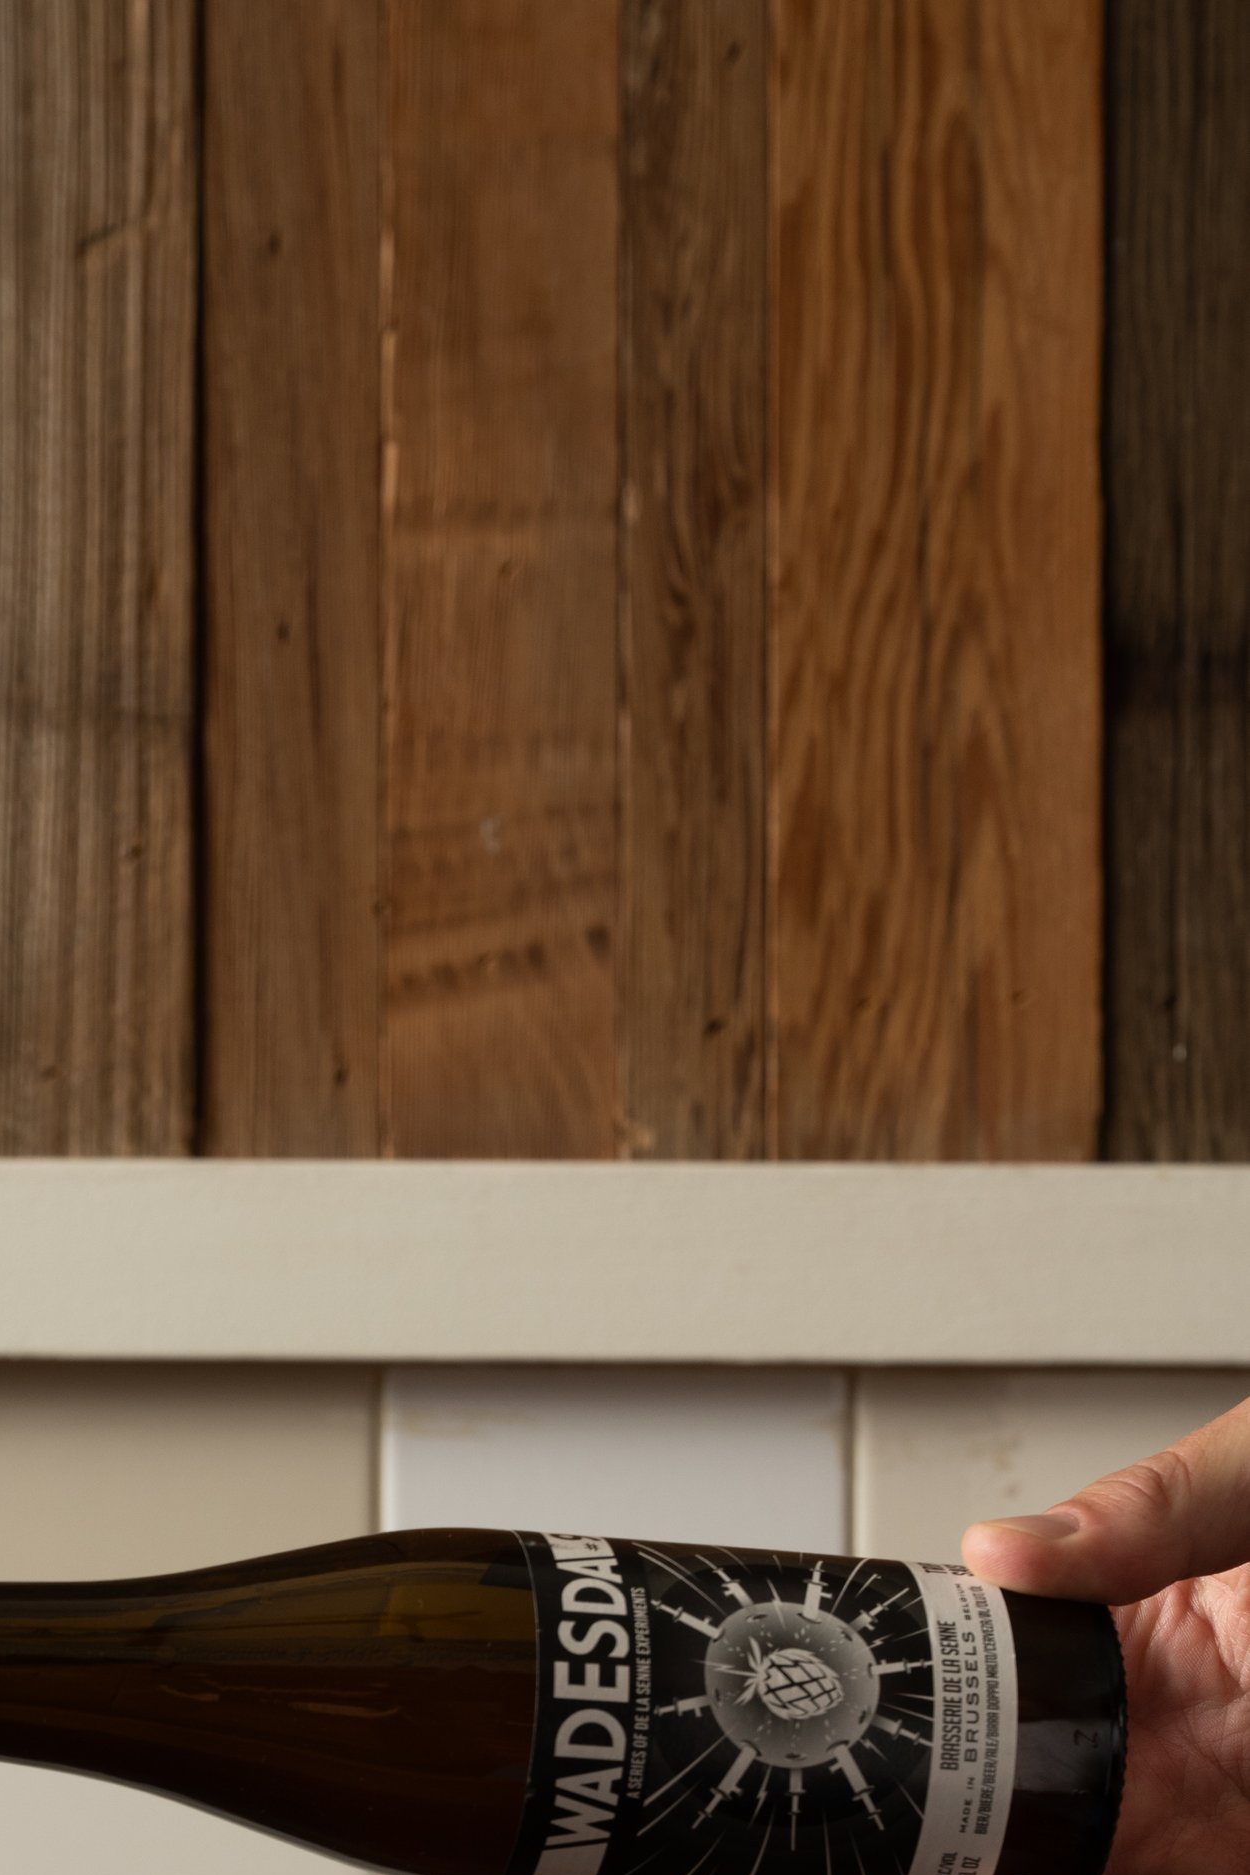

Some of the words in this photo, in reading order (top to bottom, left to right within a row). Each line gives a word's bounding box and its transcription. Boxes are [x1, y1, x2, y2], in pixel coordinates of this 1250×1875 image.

[955, 1583, 971, 1620] BELGIUM
[631, 1587, 651, 1656] EXPERIMENTS
[938, 1620, 960, 1656] SENNE
[636, 1657, 651, 1695] SENNE
[943, 1660, 961, 1674] LA
[942, 1676, 962, 1692] DE
[962, 1631, 980, 1762] BRUSSELS
[636, 1698, 650, 1713] LA
[634, 1715, 649, 1731] DE
[940, 1696, 962, 1771] BRASSERIE
[634, 1734, 648, 1749] OF
[627, 1751, 646, 1790] SERIES
[627, 1791, 640, 1799] A
[967, 1777, 975, 1790] IN
[959, 1799, 972, 1833] MADE
[962, 1856, 982, 1869] OZ
